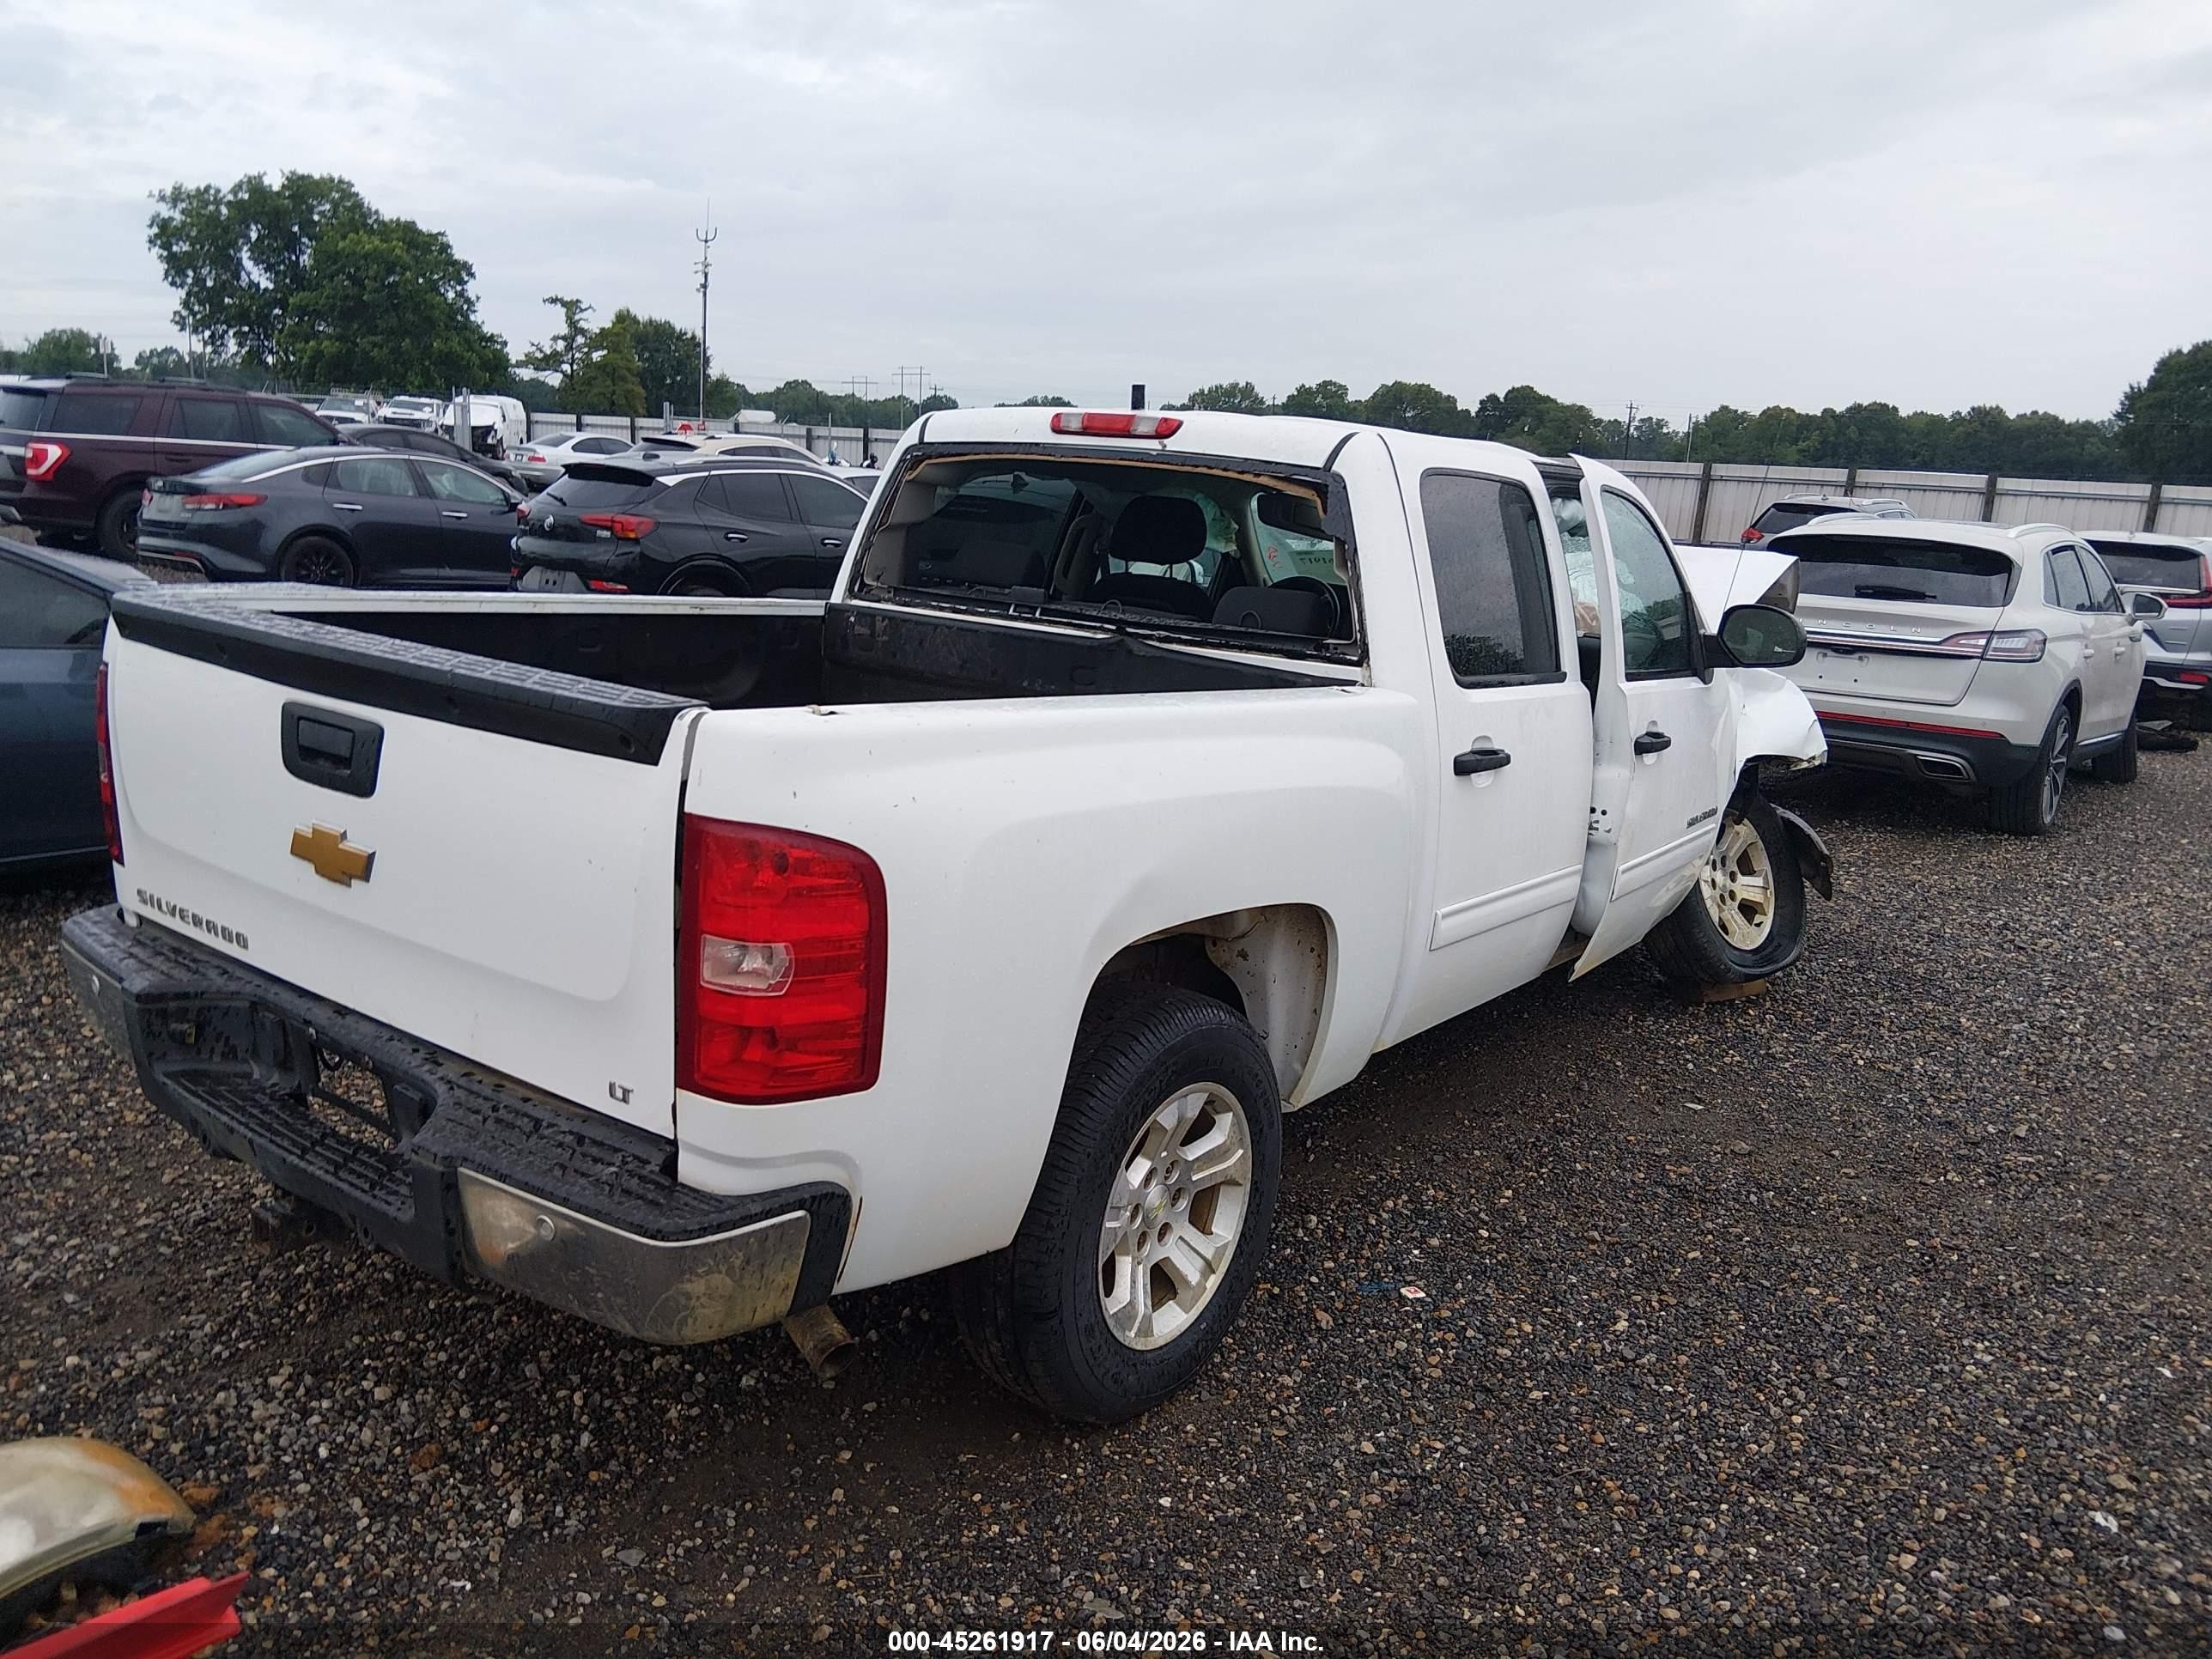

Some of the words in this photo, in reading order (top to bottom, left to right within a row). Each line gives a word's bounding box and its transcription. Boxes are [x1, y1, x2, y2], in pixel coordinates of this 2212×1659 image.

[1799, 617, 1921, 634] INCOLN
[137, 887, 249, 951] SILVERADO
[608, 1080, 634, 1105] LT
